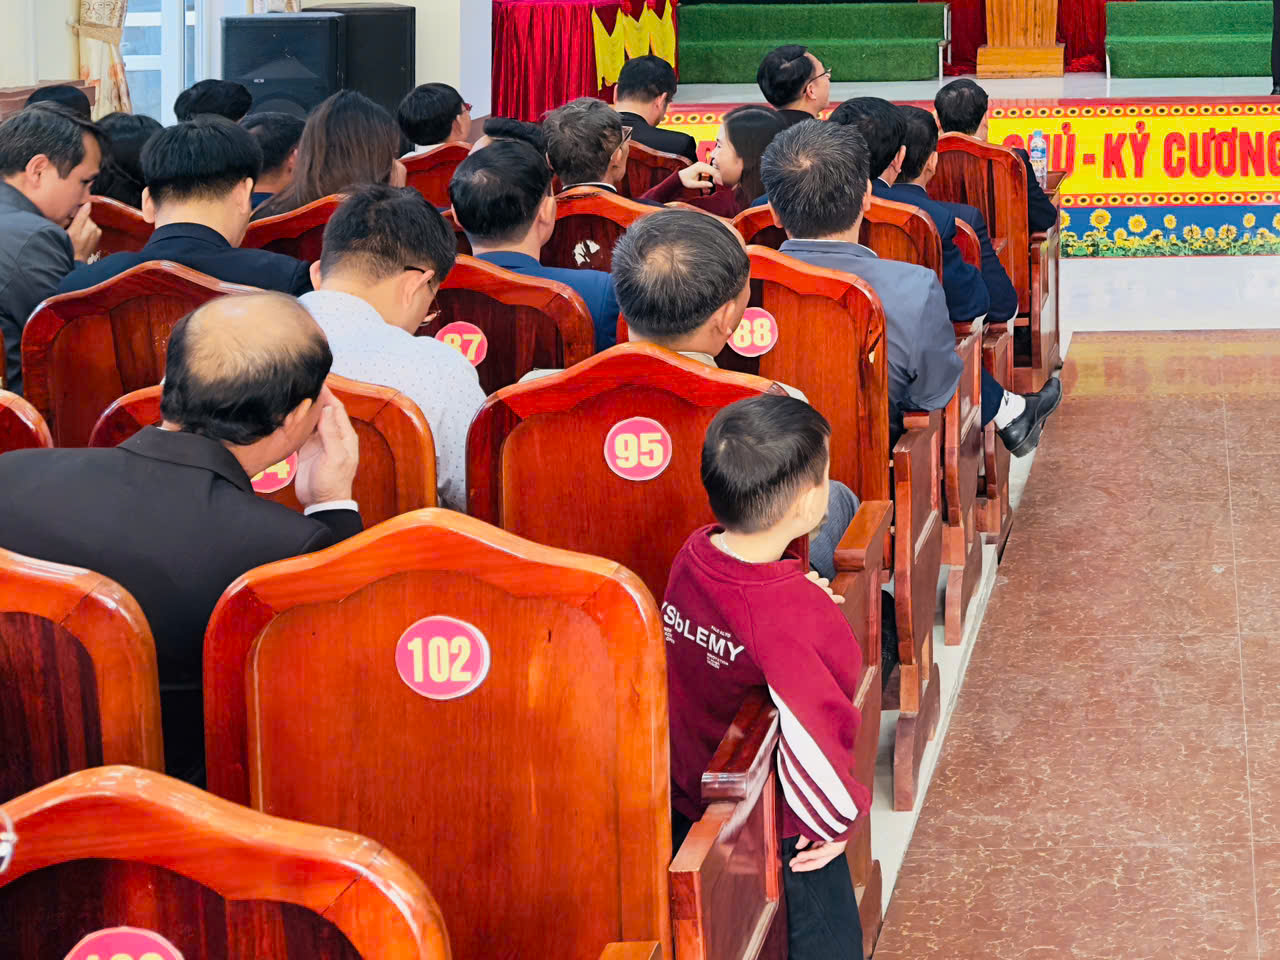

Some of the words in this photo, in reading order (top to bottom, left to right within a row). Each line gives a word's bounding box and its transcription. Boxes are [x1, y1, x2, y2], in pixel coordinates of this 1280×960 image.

[1102, 120, 1151, 179] KỶ
[732, 317, 772, 348] 88
[614, 429, 662, 462] 95
[661, 601, 745, 662] SbLEMY
[407, 634, 473, 683] 102
